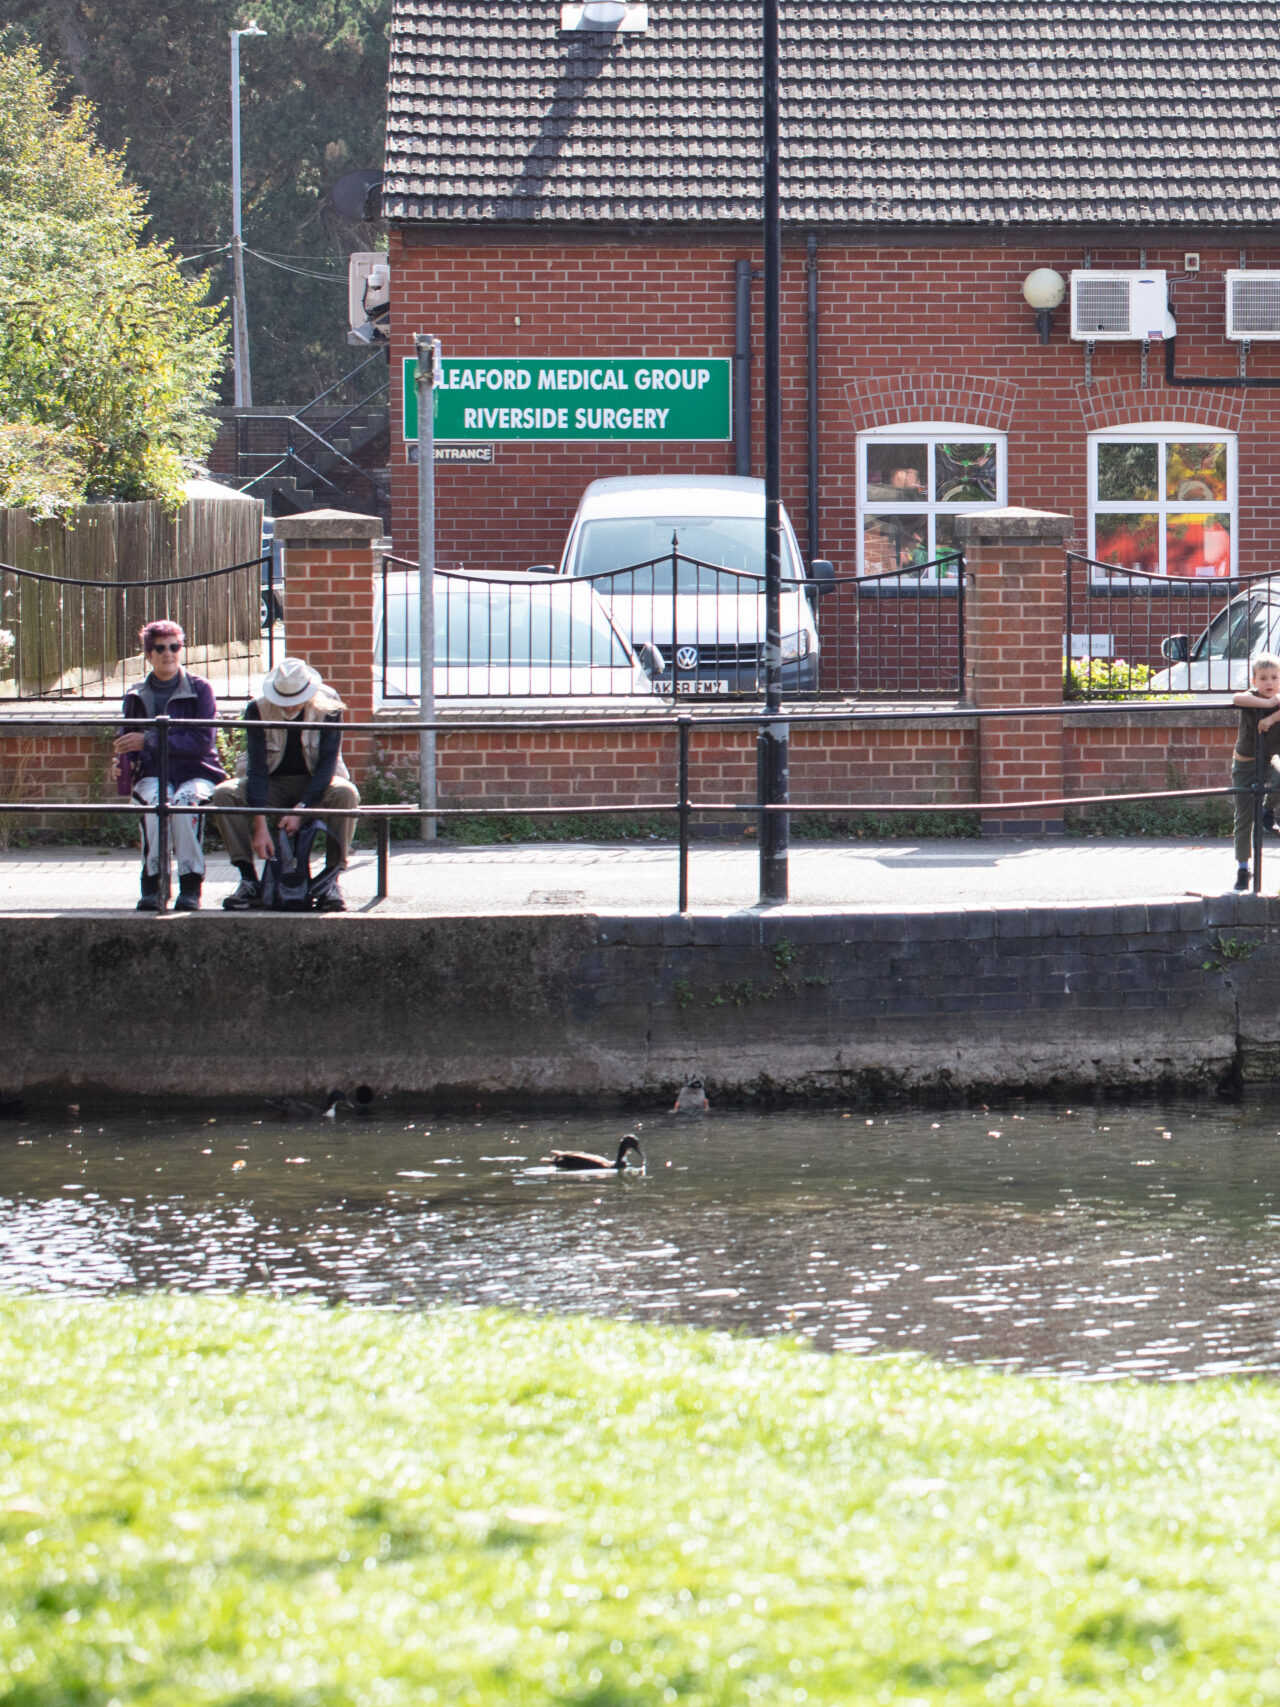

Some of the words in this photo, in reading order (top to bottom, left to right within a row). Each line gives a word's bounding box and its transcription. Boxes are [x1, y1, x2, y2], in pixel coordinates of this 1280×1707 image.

[432, 369, 531, 390] LEAFORD
[538, 369, 628, 390] MEDICAL
[634, 369, 711, 390] GROUP
[464, 408, 568, 429] RIVERSIDE
[575, 408, 670, 429] SURGERY
